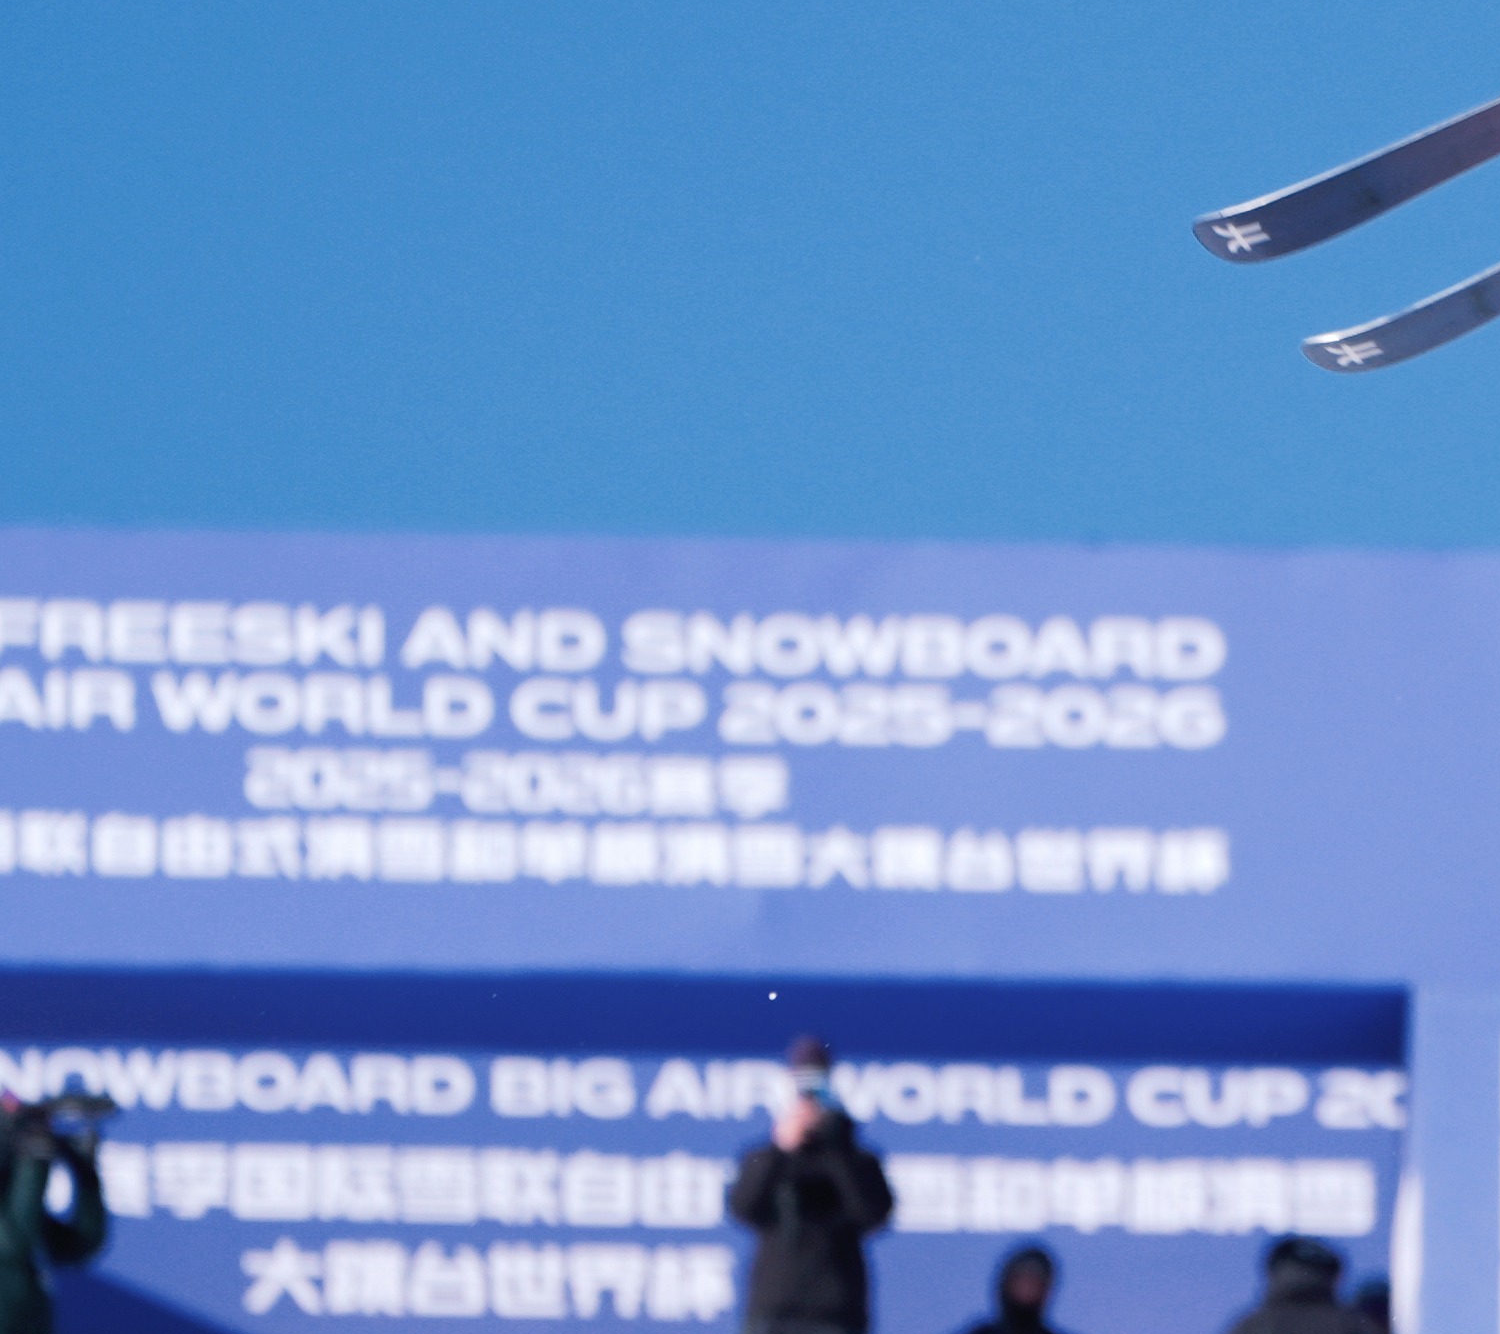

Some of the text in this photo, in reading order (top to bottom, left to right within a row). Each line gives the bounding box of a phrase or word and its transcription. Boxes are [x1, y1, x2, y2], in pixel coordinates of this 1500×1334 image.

[0, 600, 1227, 679] FREESKI AND SNOWBOARD
[0, 669, 1227, 748] AIR WORLD CUP 2025-2026
[490, 1057, 637, 1118] BIG
[645, 1059, 798, 1120] AIR
[1126, 1066, 1307, 1127] CUP
